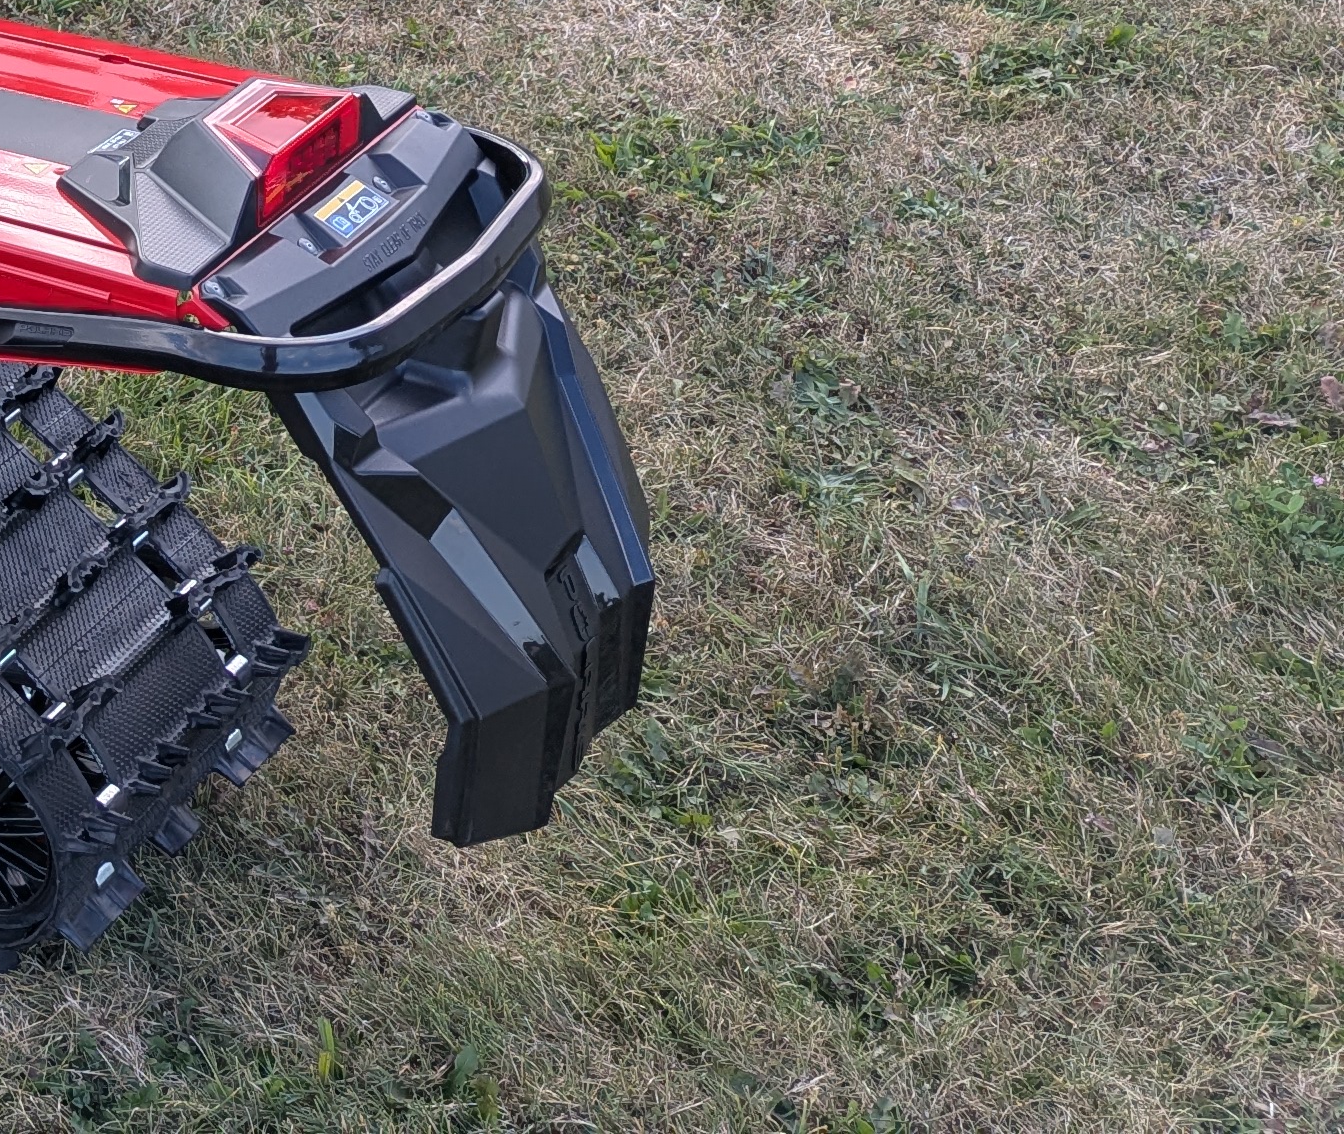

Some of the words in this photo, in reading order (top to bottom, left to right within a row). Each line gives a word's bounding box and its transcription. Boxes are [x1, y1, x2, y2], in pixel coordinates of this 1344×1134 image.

[362, 250, 384, 273] STAY
[380, 231, 405, 257] CLEAR
[399, 223, 411, 241] OF
